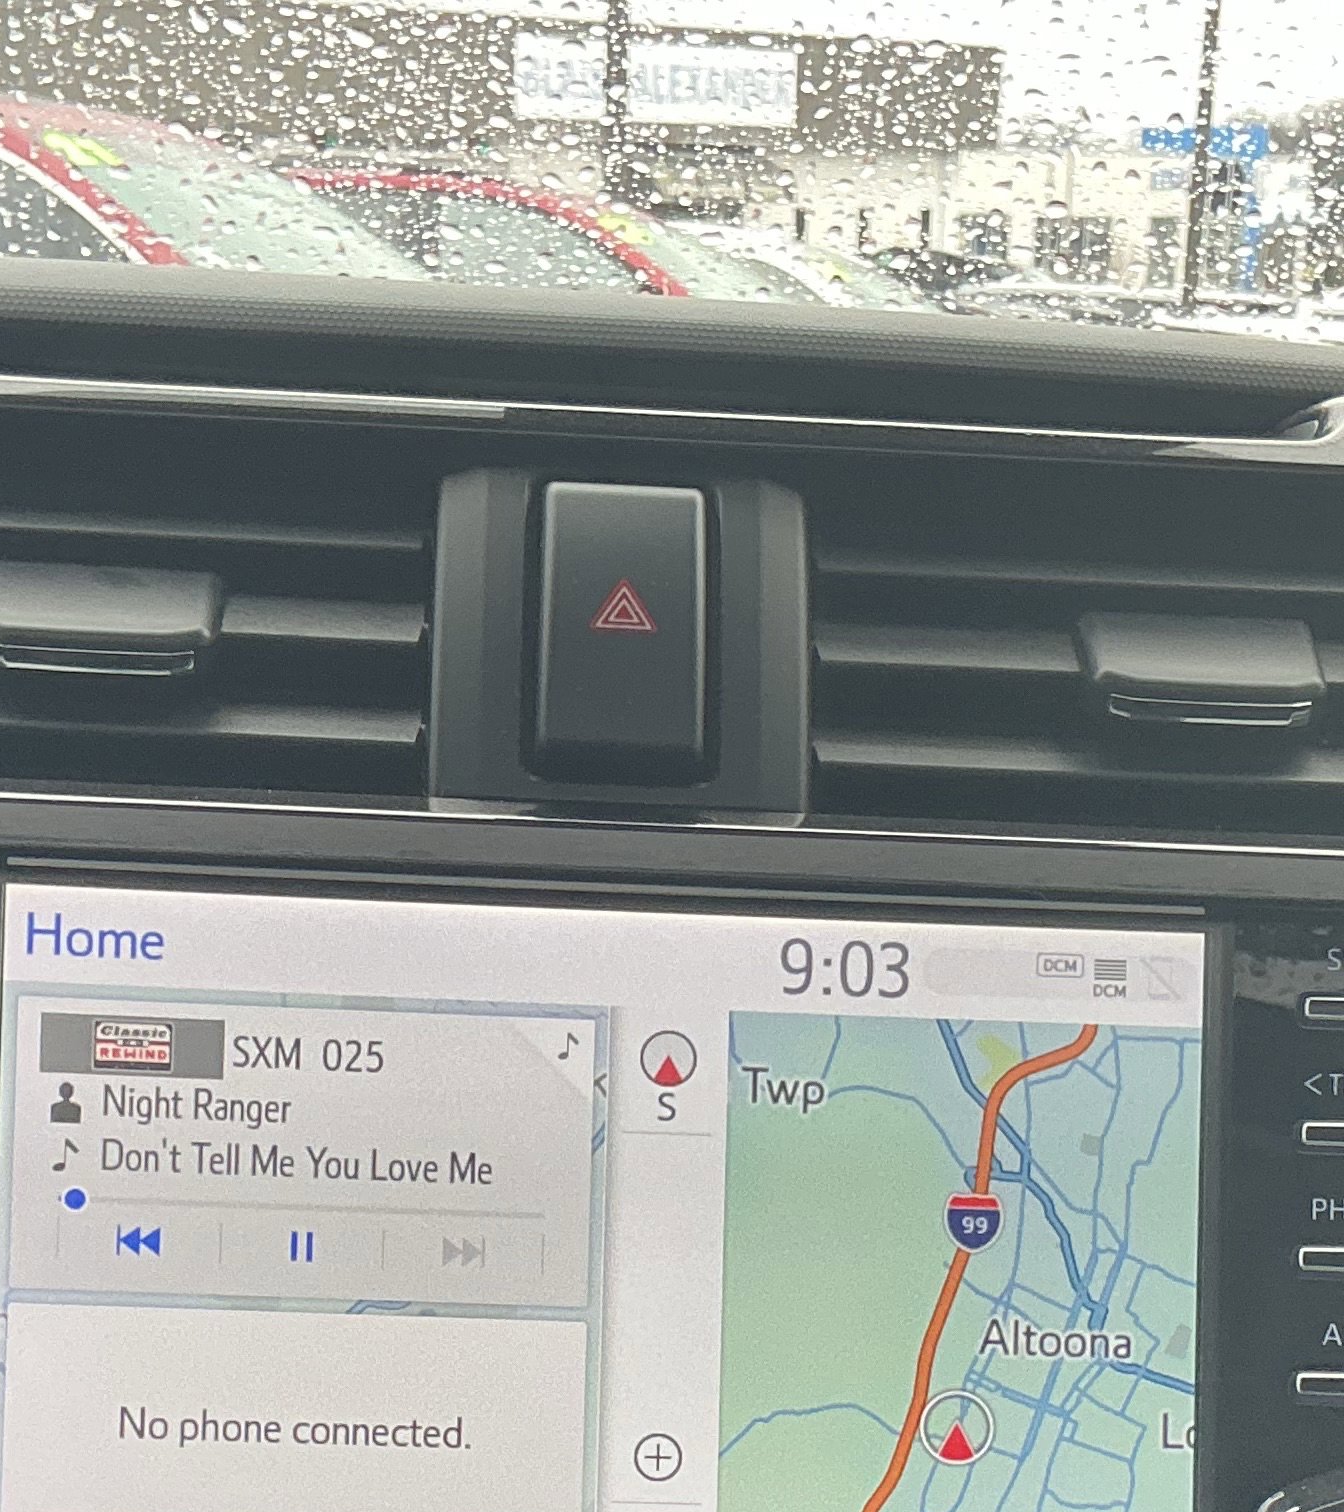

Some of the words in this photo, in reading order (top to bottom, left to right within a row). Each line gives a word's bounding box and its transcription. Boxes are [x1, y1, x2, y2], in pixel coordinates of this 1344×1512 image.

[24, 910, 166, 961] Home
[778, 936, 912, 1000] 9:03
[1043, 957, 1078, 973] DCM
[1092, 982, 1127, 998] DCM
[100, 1025, 168, 1039] Classic
[99, 1047, 168, 1061] REWIND
[232, 1036, 302, 1071] SXM
[322, 1038, 386, 1074] 025
[102, 1084, 184, 1124] Night
[193, 1087, 292, 1130] Ranger
[656, 1093, 677, 1122] S
[741, 1064, 826, 1114] Twp
[101, 1137, 182, 1175] Don't
[191, 1141, 241, 1177] Tell
[251, 1144, 296, 1178] Me
[305, 1146, 360, 1181] You
[371, 1148, 440, 1184] Love
[449, 1151, 494, 1186] Me
[960, 1215, 989, 1236] 99
[977, 1319, 1133, 1360] Altoona
[117, 1405, 170, 1441] No
[178, 1409, 282, 1449] phone
[292, 1415, 473, 1451] connected.
